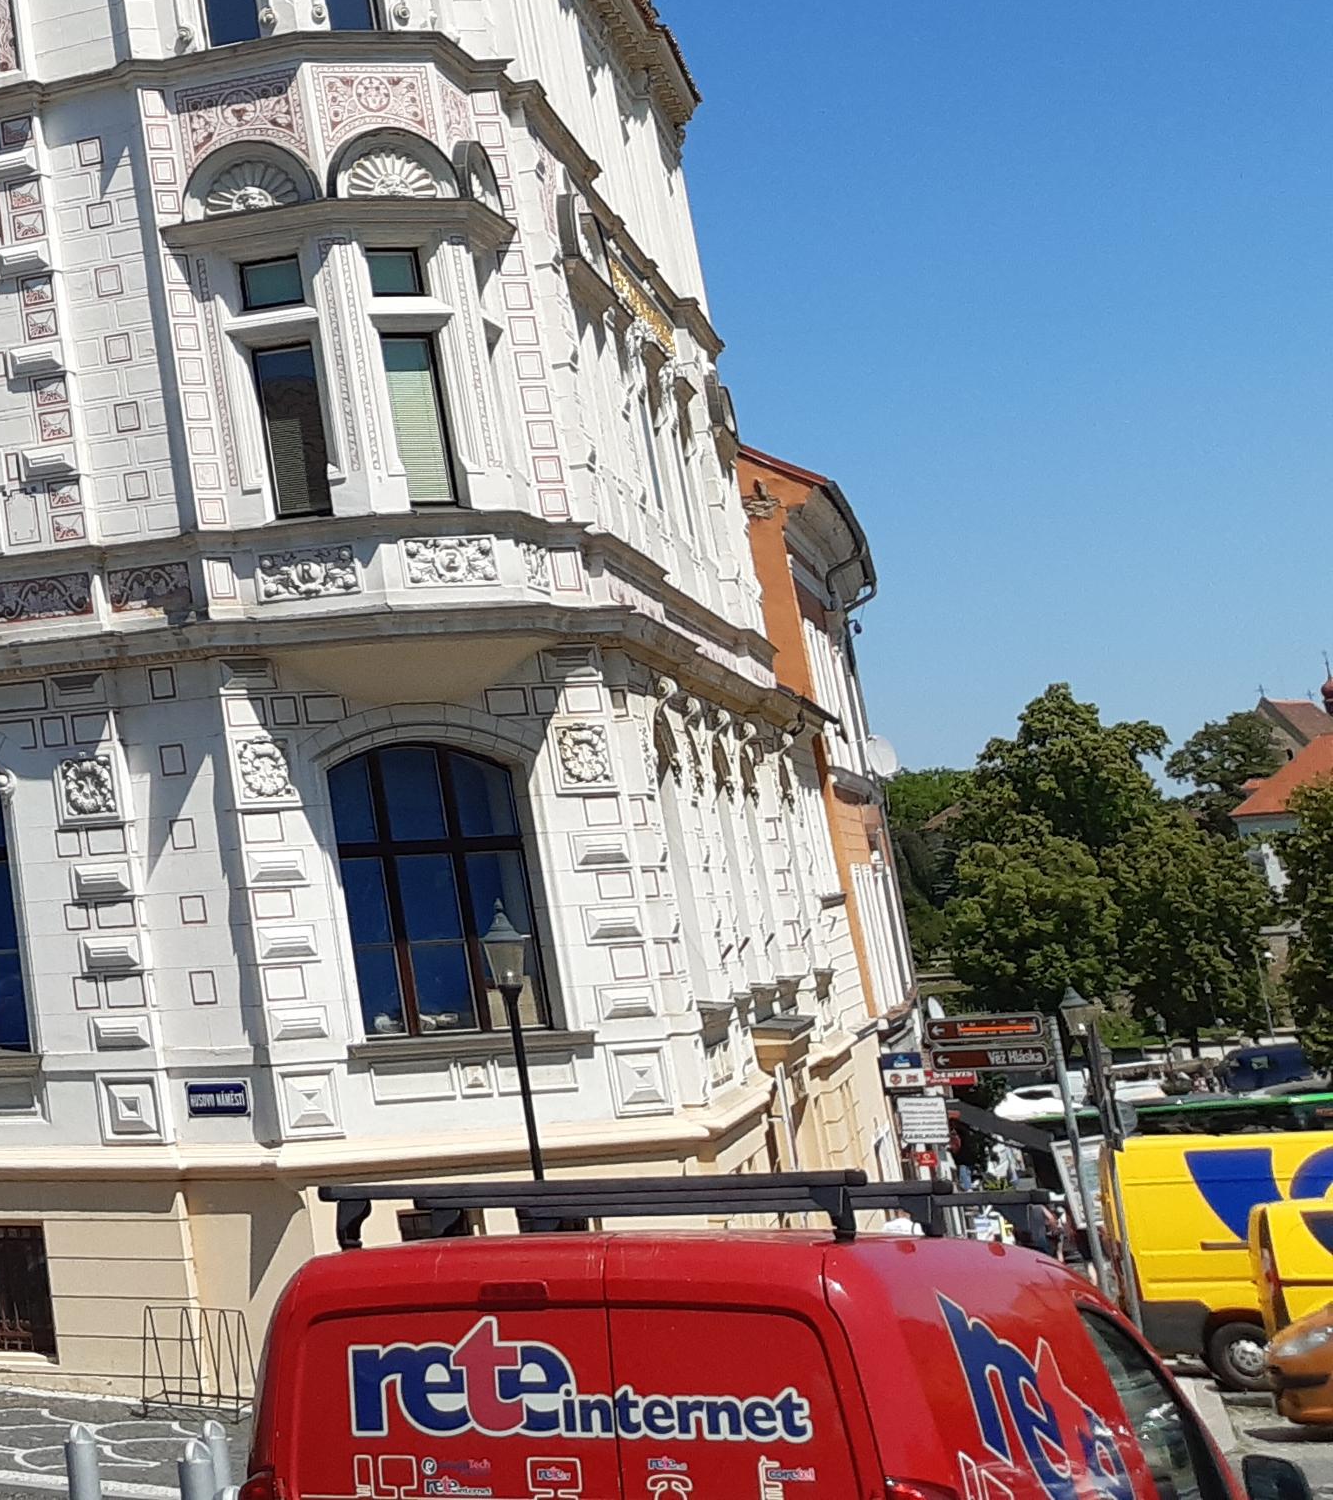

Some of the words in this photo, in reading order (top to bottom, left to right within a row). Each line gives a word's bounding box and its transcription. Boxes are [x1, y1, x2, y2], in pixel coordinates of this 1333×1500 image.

[1008, 1050, 1044, 1064] Hláska
[349, 1317, 576, 1437] rete
[562, 1385, 812, 1443] internet
